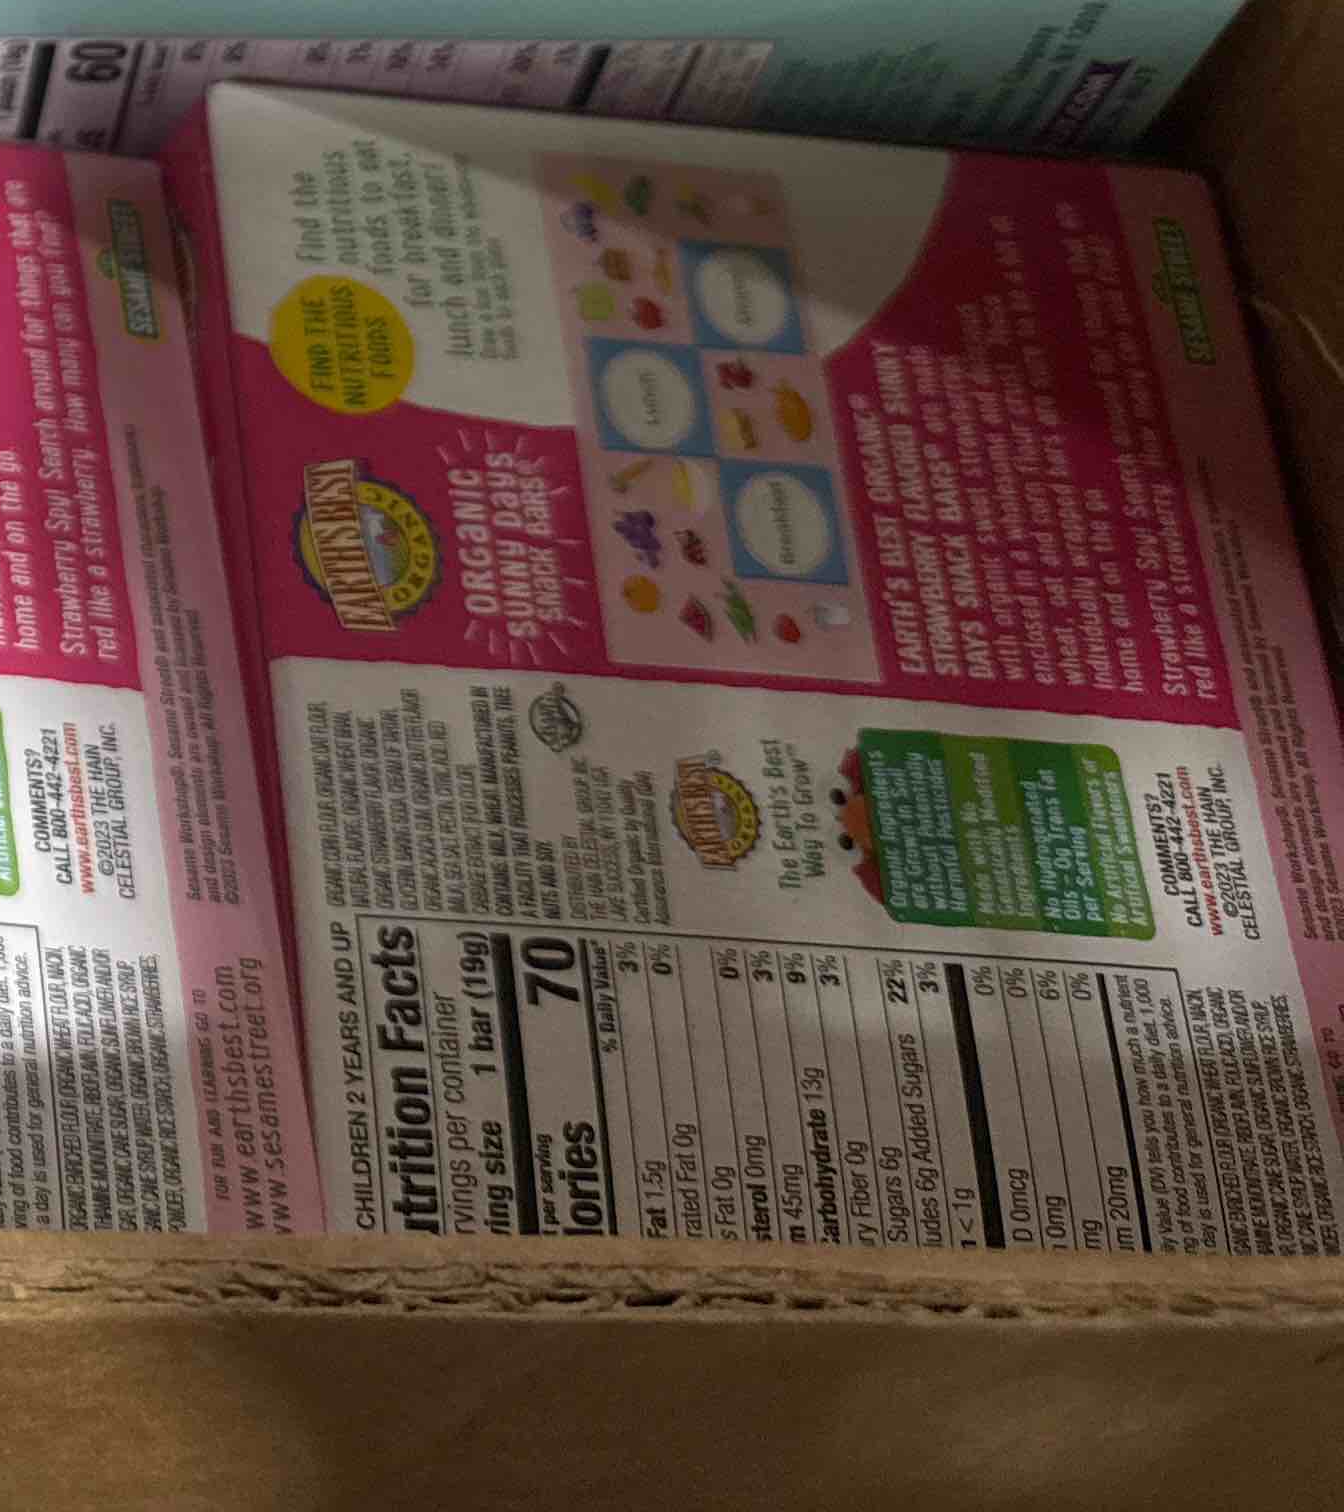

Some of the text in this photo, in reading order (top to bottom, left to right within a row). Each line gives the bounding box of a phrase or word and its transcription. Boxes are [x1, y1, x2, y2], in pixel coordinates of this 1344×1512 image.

[66, 41, 127, 83] 60
[23, 747, 51, 854] COMMENTS?
[40, 728, 73, 886] CALL 800-442-4221
[63, 722, 95, 895] www.earthsbest.com
[1143, 793, 1179, 896] COMMENTS?
[1155, 772, 1202, 927] CALL 800-442-4221
[1176, 766, 1223, 936] www.earthsbest.com
[370, 925, 424, 1052] Facts
[457, 931, 493, 1000] (19g)
[520, 937, 580, 1006] 70
